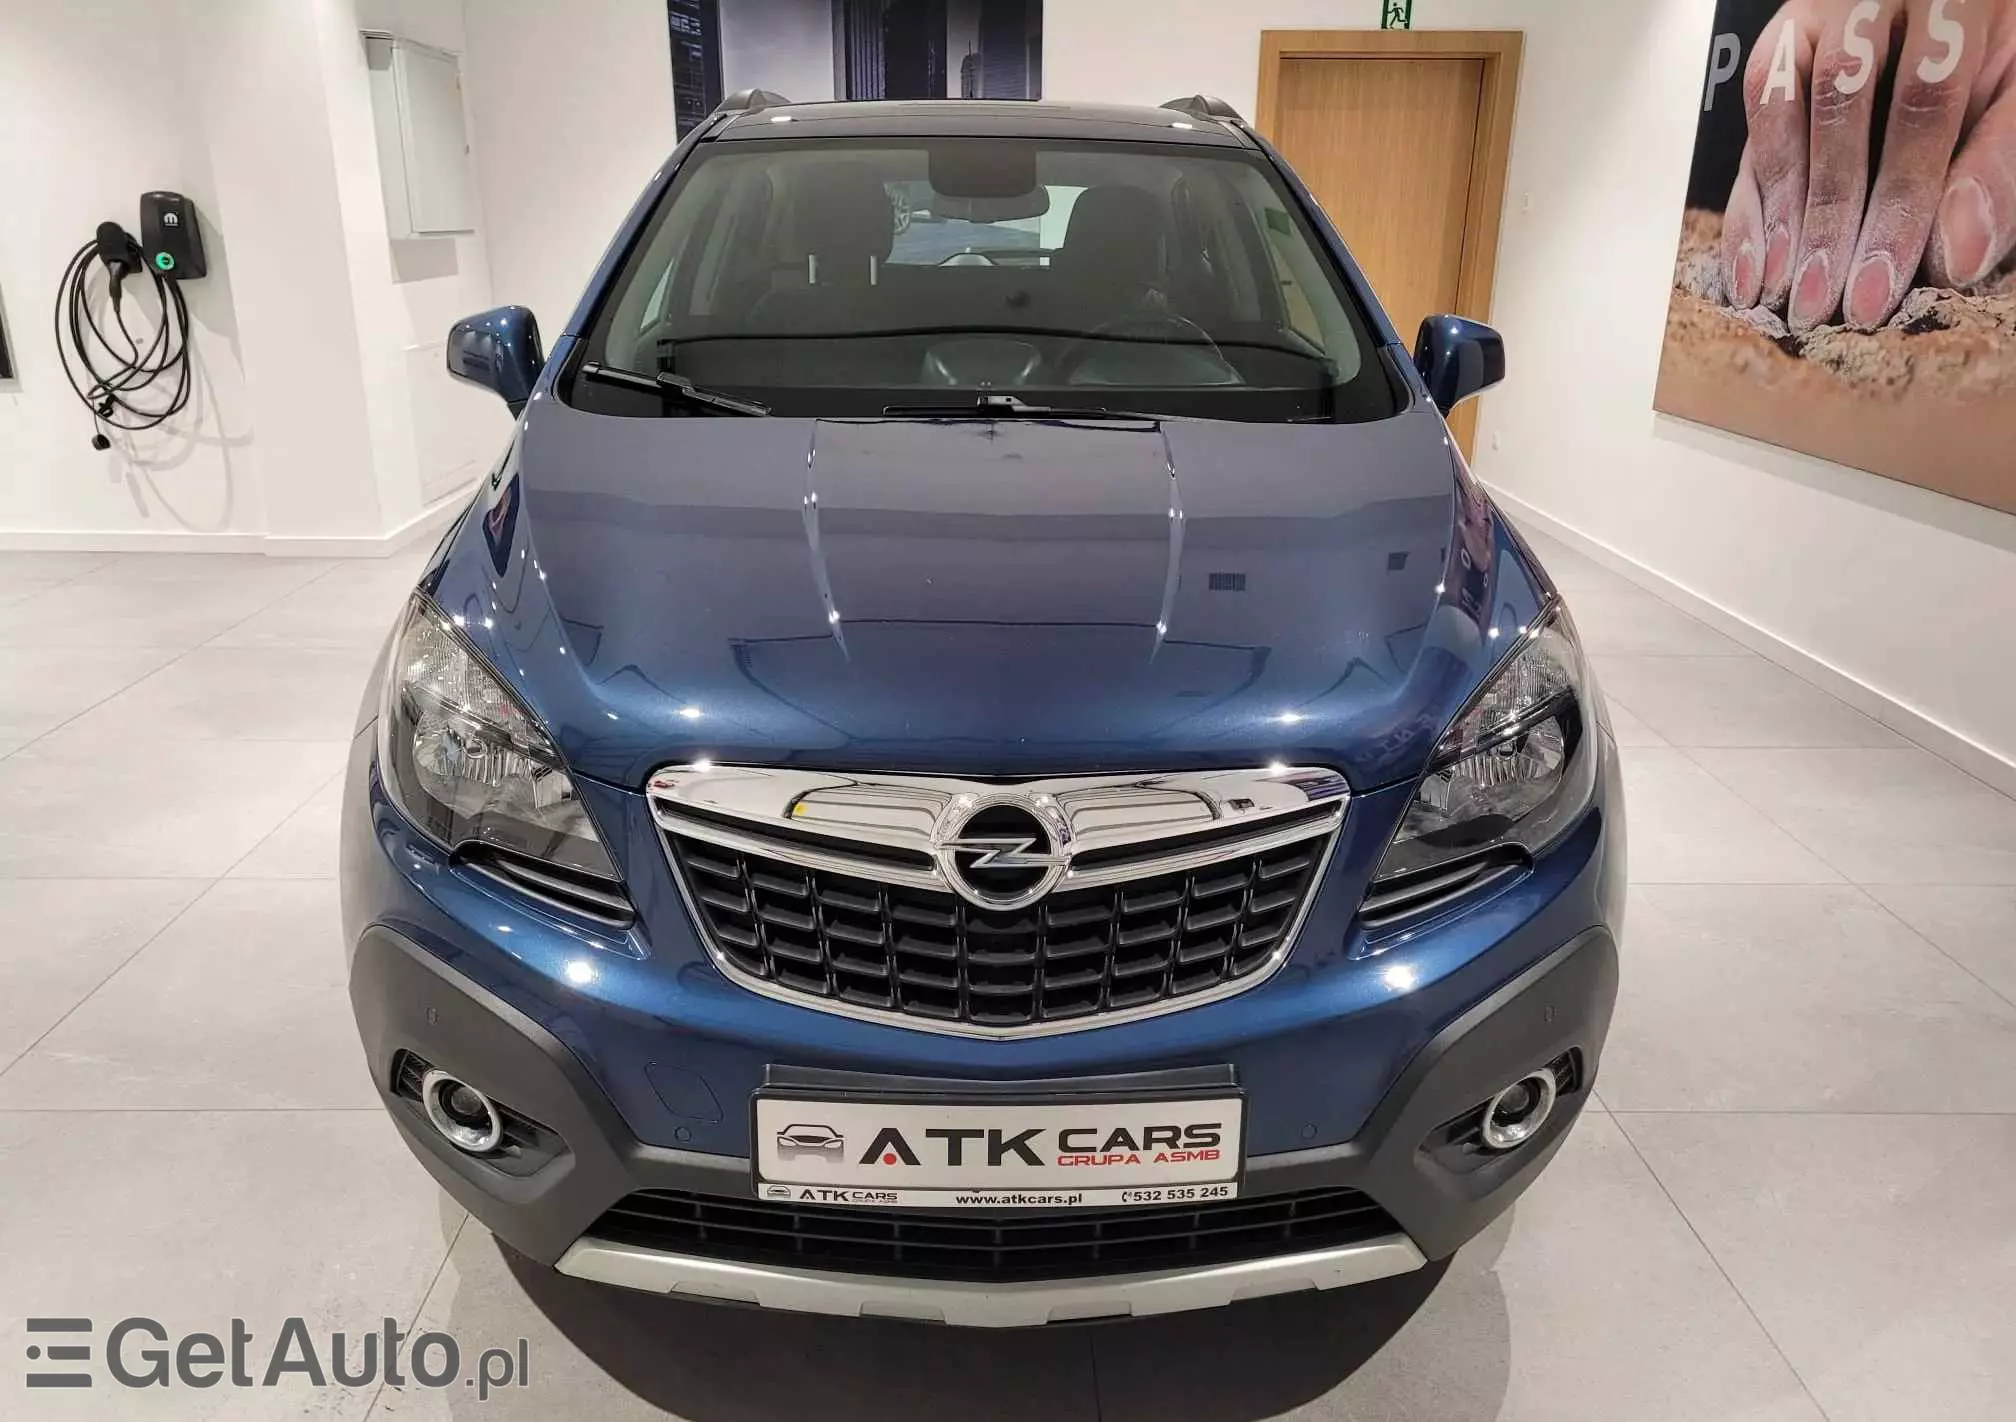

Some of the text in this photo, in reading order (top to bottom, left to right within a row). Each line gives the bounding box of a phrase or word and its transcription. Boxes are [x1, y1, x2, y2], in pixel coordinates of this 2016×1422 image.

[1703, 0, 1965, 112] PASS
[858, 1122, 1222, 1167] ATK CARS
[1057, 1149, 1221, 1167] GRUPA ASMB
[799, 1188, 849, 1202] ATK
[851, 1191, 898, 1200] CARS
[955, 1192, 1083, 1206] www.atkcars.pl
[1133, 1186, 1229, 1202] 532 535 245
